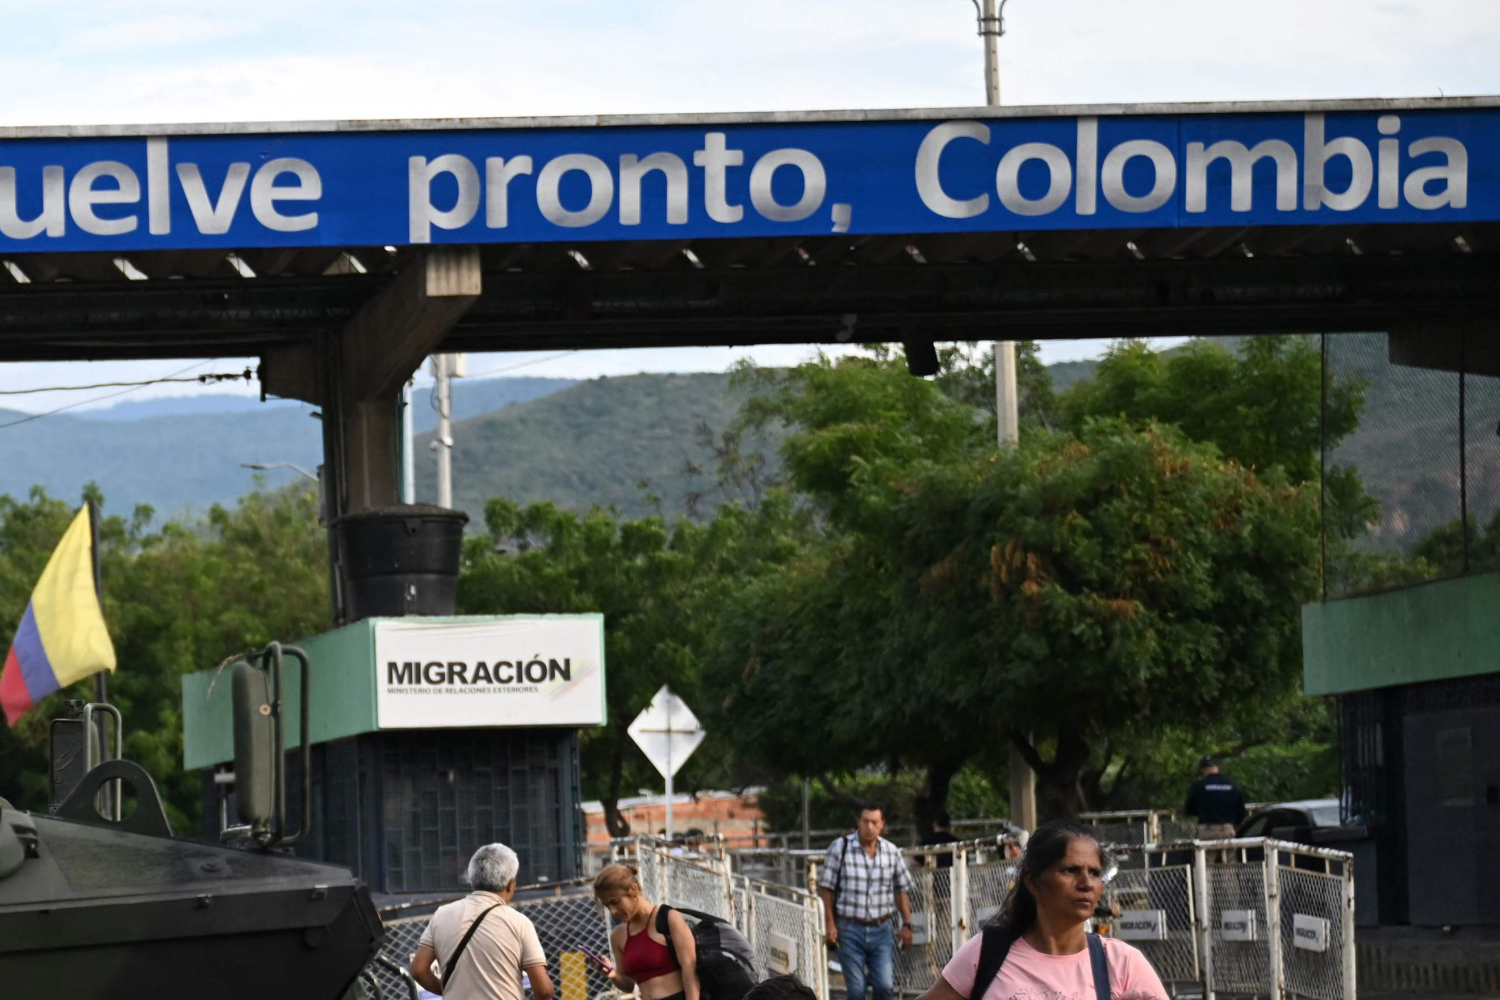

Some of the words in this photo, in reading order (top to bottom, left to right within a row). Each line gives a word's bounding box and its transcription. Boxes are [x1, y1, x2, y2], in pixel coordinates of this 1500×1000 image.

[408, 131, 852, 244] pronto,
[914, 112, 1468, 220] Colombia
[386, 653, 572, 686] MIGRACIÓN
[386, 687, 432, 695] MINISTERIO
[432, 687, 443, 695] DE
[444, 686, 492, 695] RELACIONES
[492, 685, 539, 694] EXTERIORES
